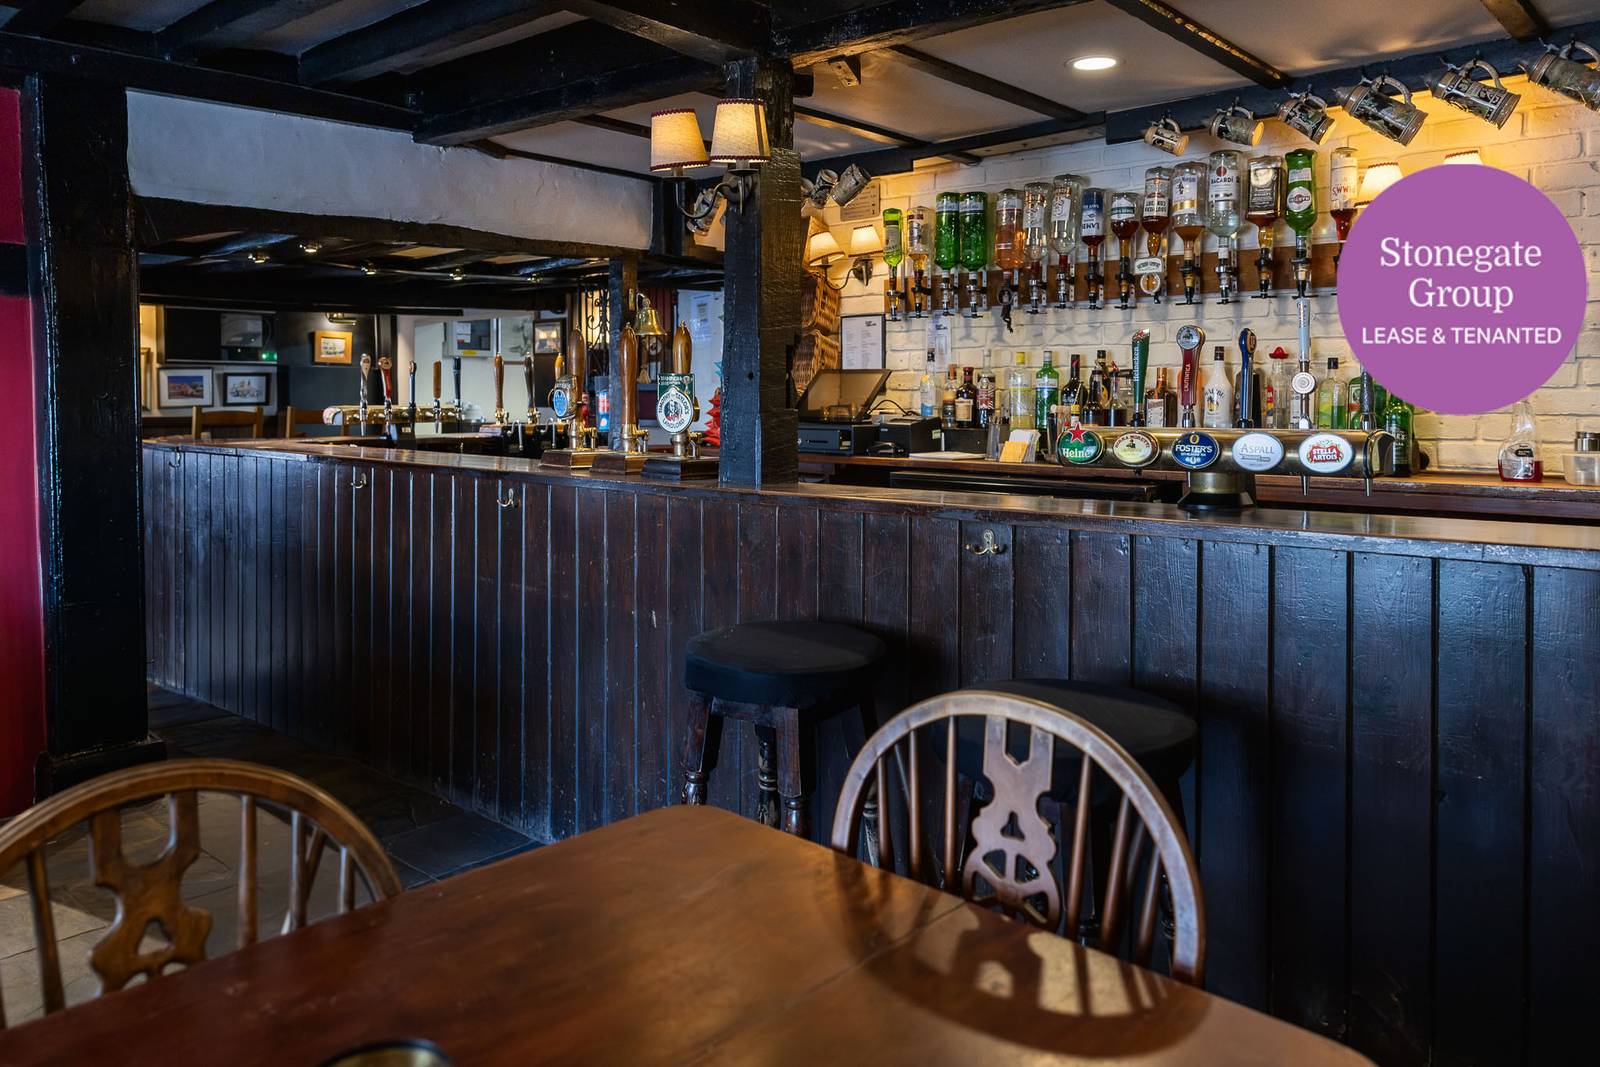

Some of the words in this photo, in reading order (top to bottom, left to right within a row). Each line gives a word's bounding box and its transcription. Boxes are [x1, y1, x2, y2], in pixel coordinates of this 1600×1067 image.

[663, 418, 685, 429] LANDLORD
[1175, 444, 1213, 453] FOSTER'S
[1241, 443, 1275, 454] ASPALL
